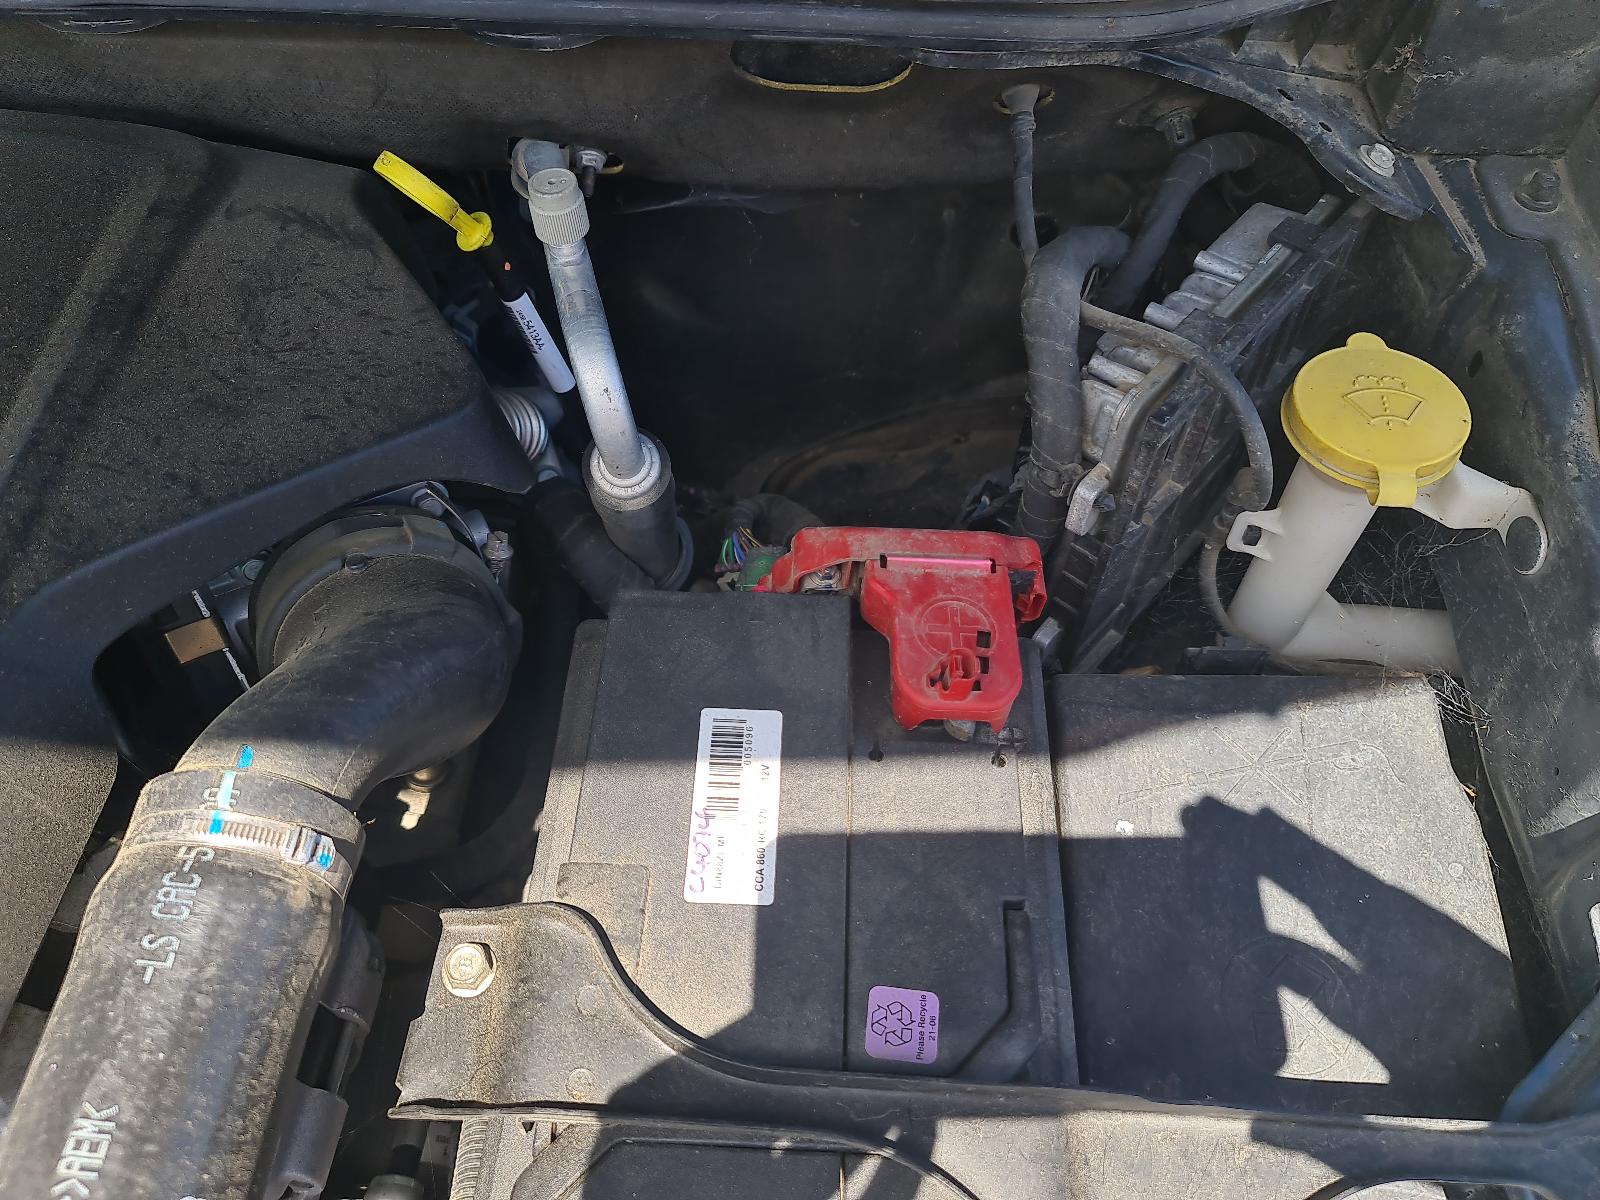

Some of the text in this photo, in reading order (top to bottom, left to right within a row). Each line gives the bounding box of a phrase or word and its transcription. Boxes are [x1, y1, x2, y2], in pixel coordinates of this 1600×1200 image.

[743, 726, 753, 766] 005096
[761, 764, 770, 781] 12V
[757, 847, 766, 867] 860
[754, 867, 765, 892] CCA
[916, 994, 928, 1060] Please Recycle
[928, 1015, 937, 1041] 21-06
